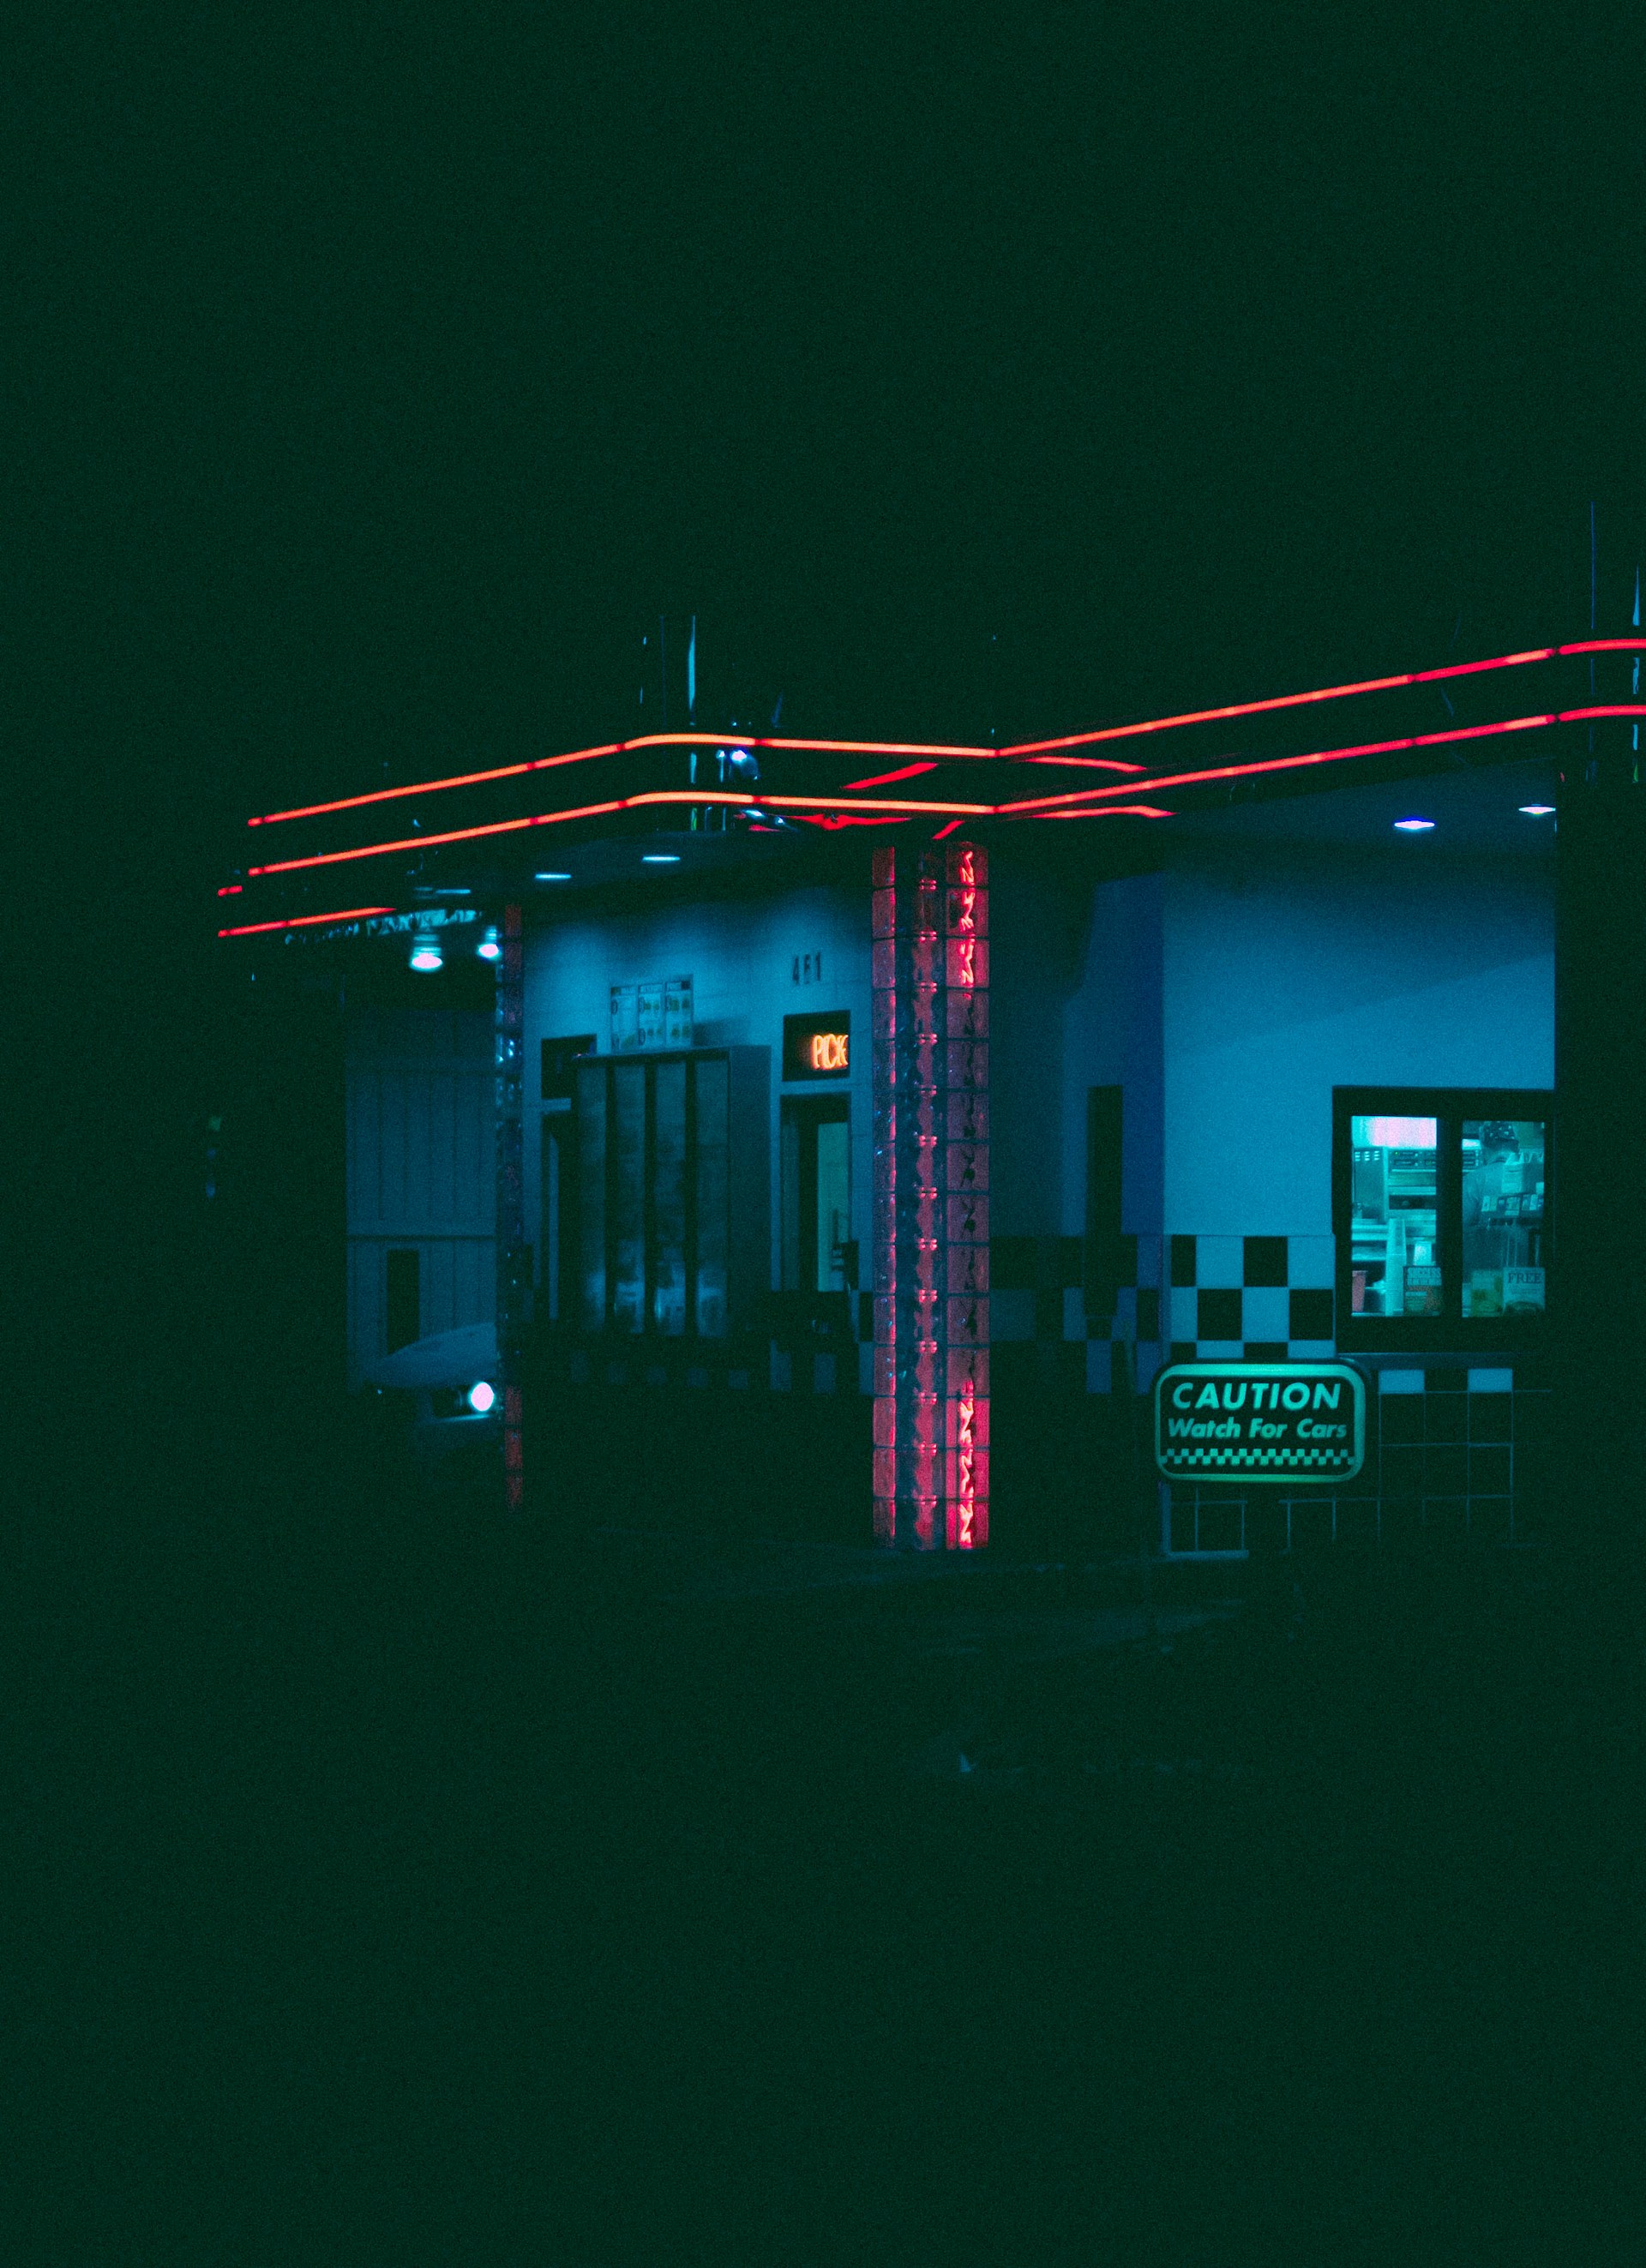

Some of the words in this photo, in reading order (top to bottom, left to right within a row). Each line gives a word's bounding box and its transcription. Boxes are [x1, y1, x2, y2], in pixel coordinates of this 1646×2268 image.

[1507, 1272, 1541, 1284] FREE
[1172, 1382, 1342, 1411] CAUTION
[1168, 1416, 1241, 1439] Watch
[1249, 1418, 1288, 1439] For
[1296, 1418, 1347, 1439] Cars
